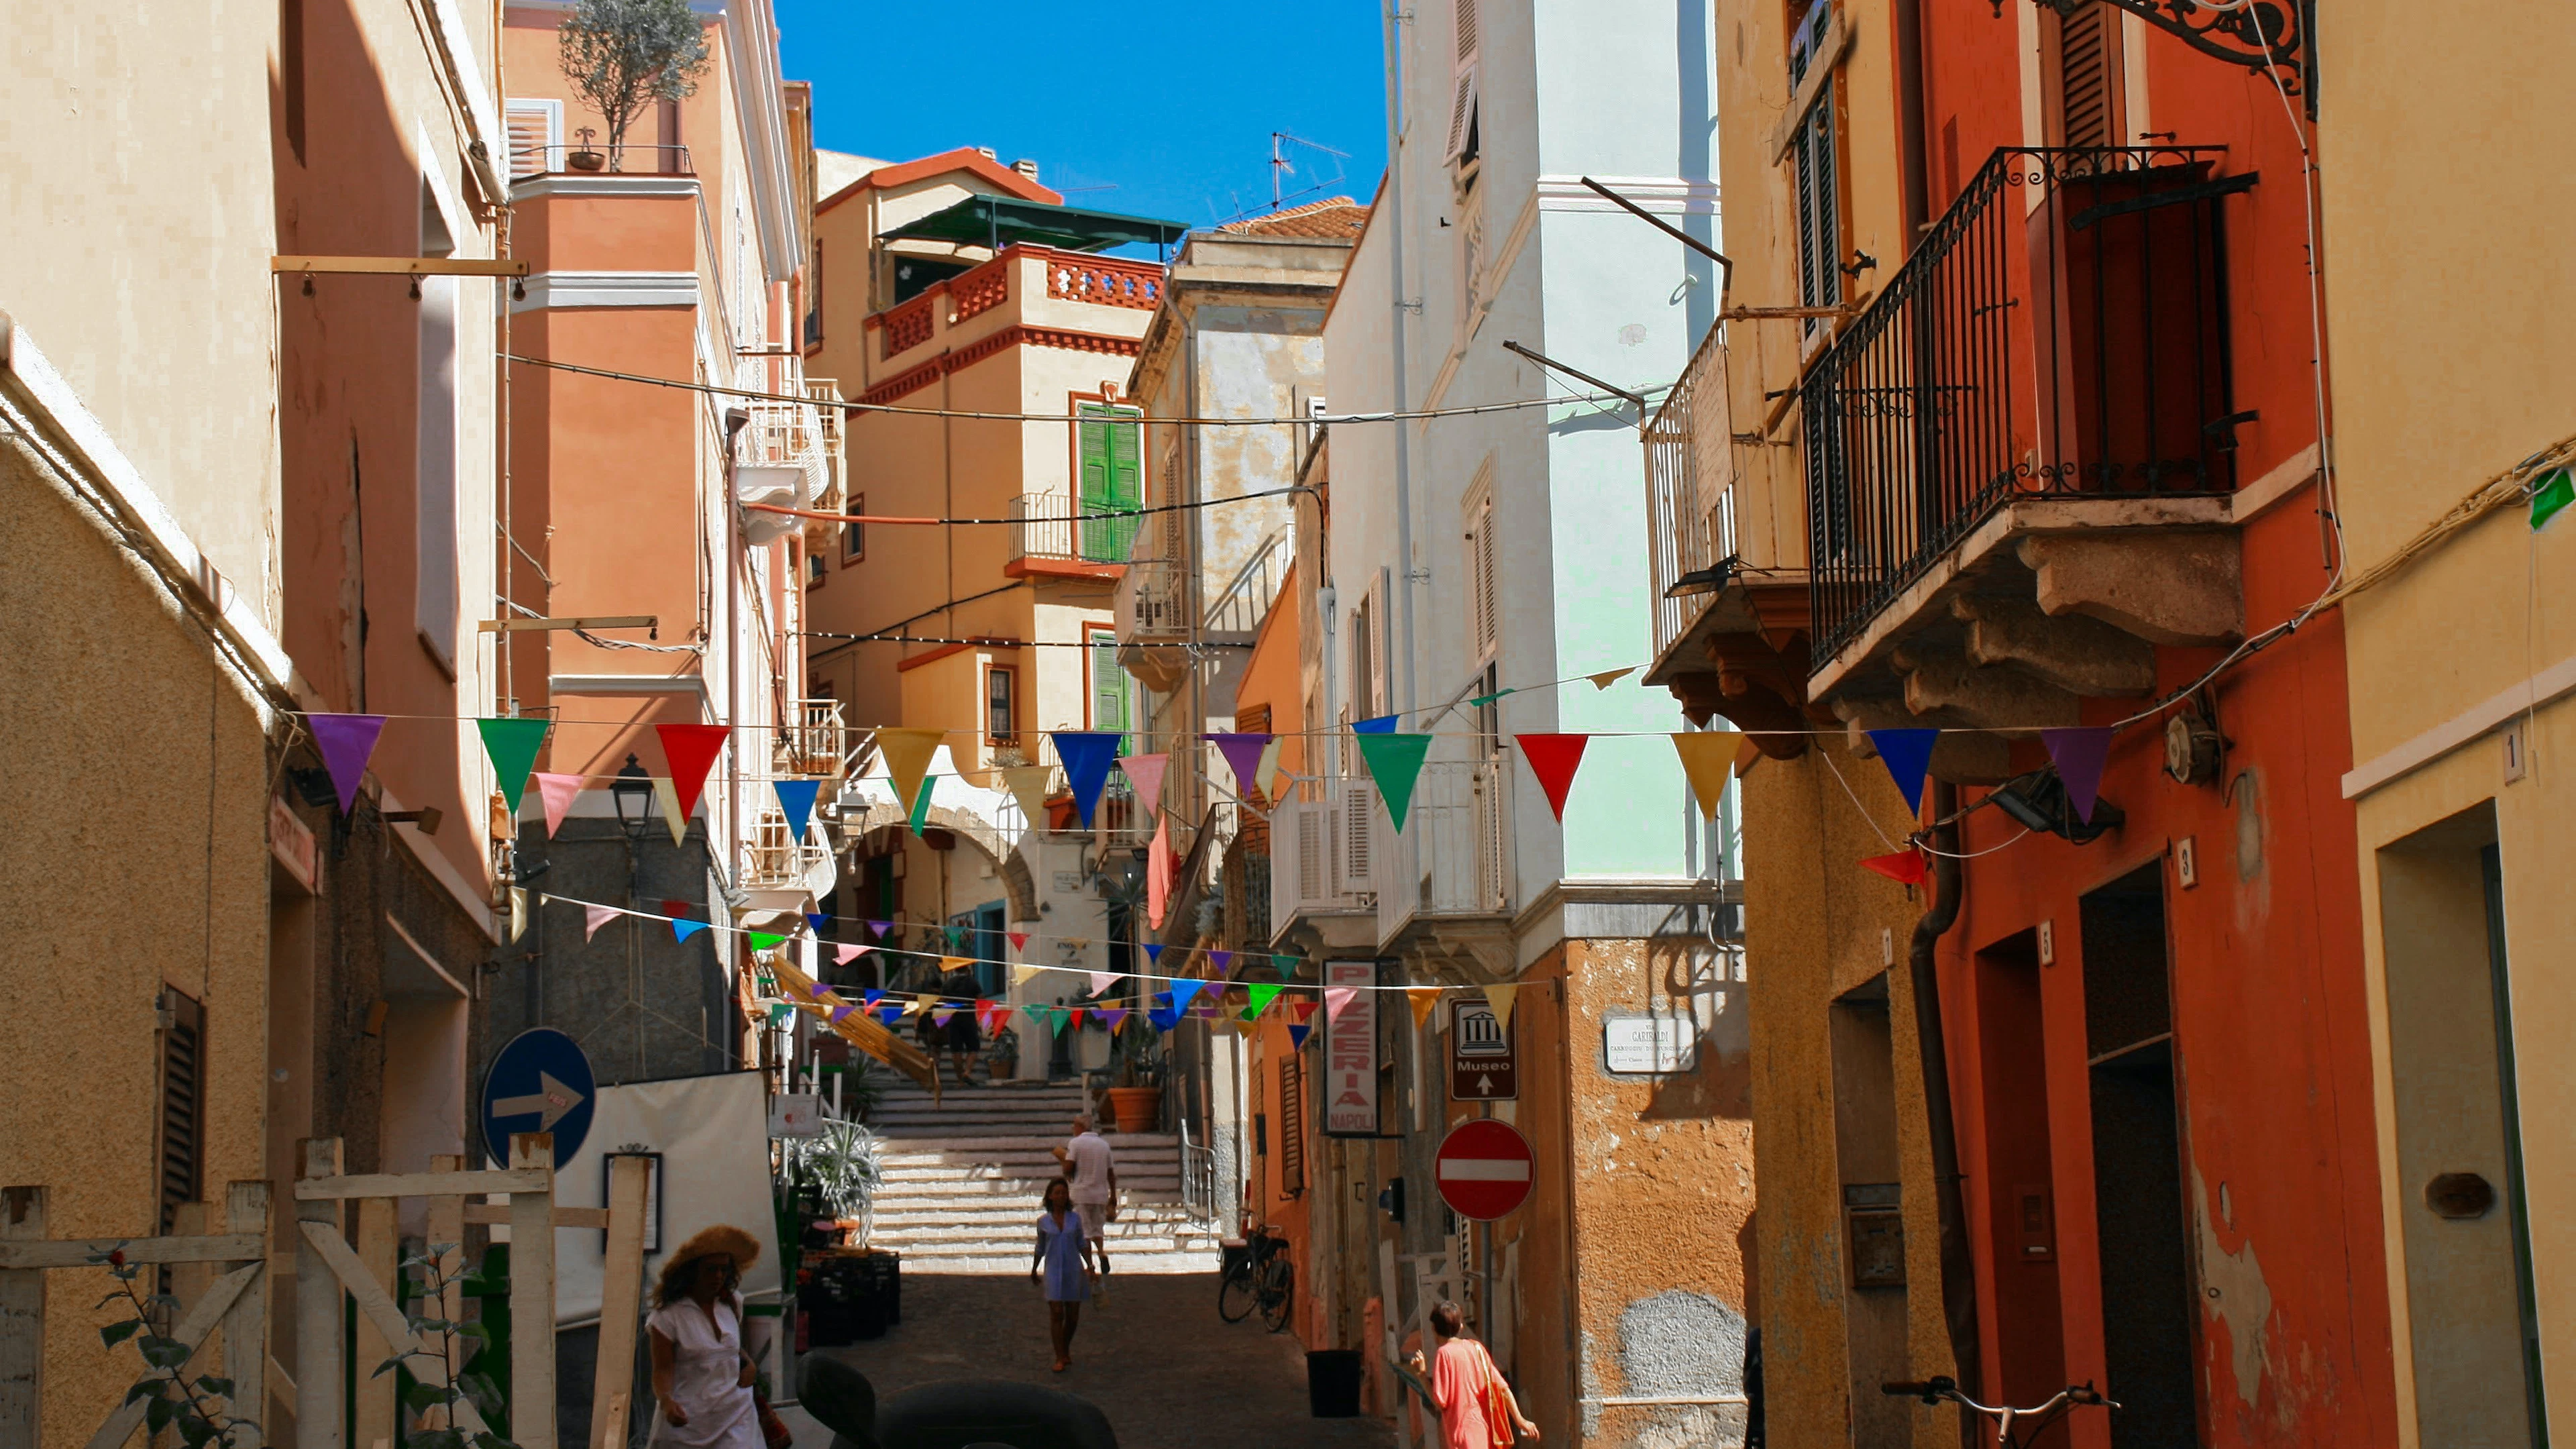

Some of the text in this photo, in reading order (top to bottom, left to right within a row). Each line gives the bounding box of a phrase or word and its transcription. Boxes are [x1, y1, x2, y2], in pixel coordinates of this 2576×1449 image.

[2508, 735, 2514, 767] 1
[2182, 849, 2189, 875] 3
[1333, 967, 1369, 1106] PZZERIA
[1458, 1061, 1510, 1071] Museo
[1331, 1114, 1374, 1130] NAPOLI
